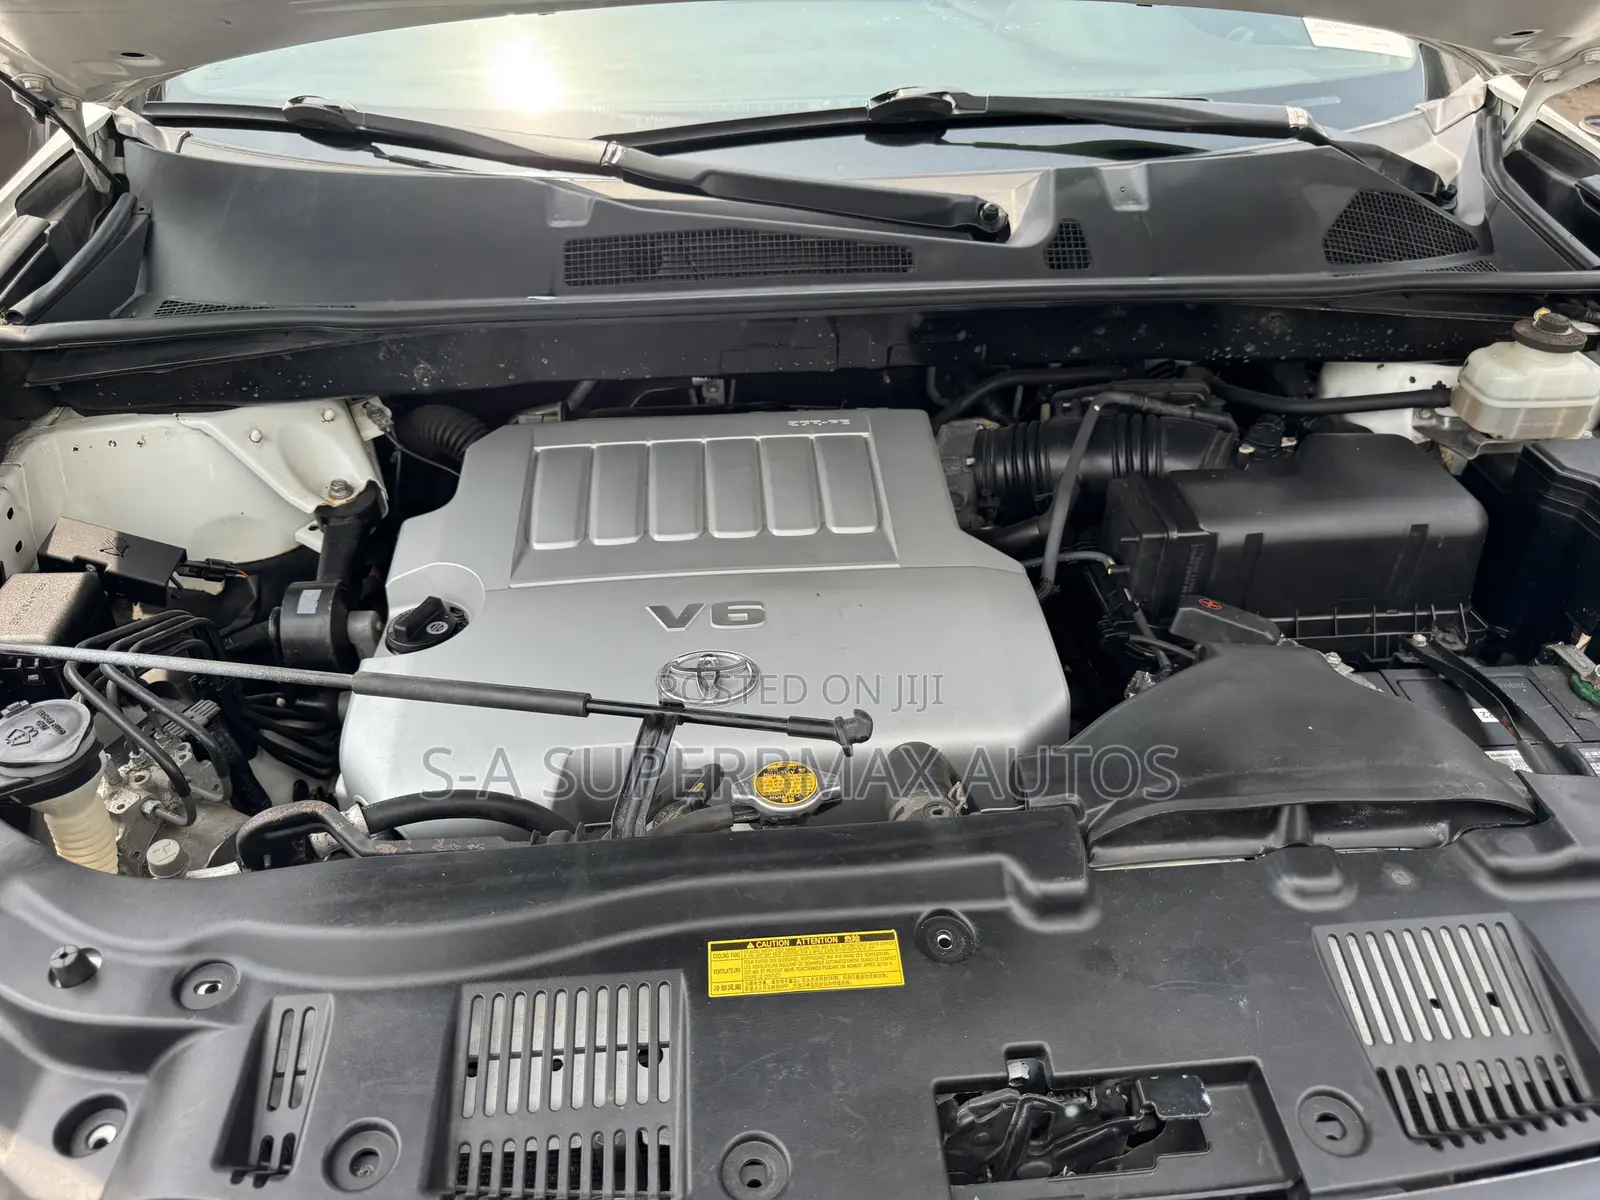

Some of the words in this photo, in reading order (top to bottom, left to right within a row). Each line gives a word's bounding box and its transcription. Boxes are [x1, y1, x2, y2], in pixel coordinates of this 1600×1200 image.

[645, 600, 765, 631] V6
[756, 940, 789, 948] CAUTION
[796, 936, 839, 946] ATTENTION
